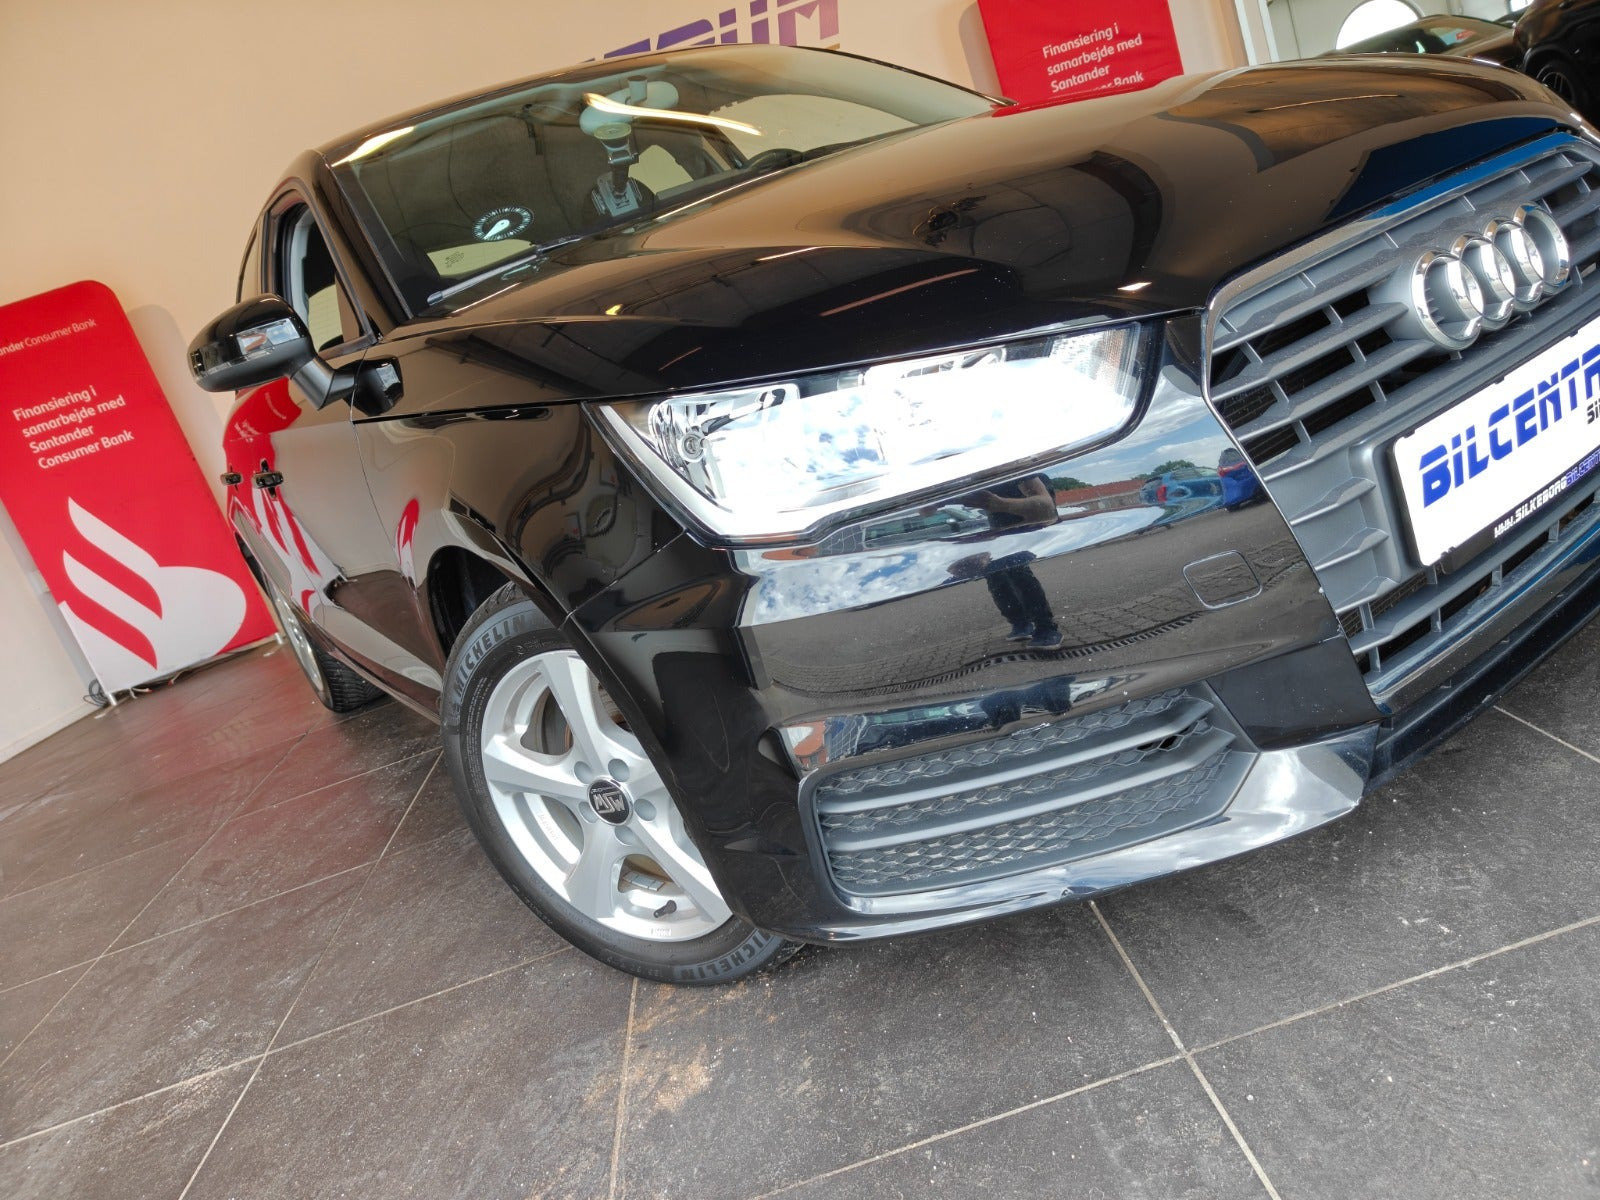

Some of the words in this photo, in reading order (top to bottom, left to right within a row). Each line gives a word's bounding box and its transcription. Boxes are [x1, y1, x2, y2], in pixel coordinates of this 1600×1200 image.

[1042, 29, 1114, 58] Finansiering
[1113, 22, 1120, 35] i
[1046, 44, 1115, 76] samarbejde
[1116, 33, 1143, 53] med
[1050, 65, 1110, 93] Santander
[24, 327, 72, 347] Consumer
[72, 318, 97, 333] Bank
[13, 388, 91, 421] Finansiering
[91, 385, 97, 397] i
[22, 405, 96, 438] samarbejde
[97, 395, 126, 414] med
[29, 424, 95, 454] Santander
[38, 440, 100, 470] Consumer
[102, 429, 135, 449] Bank
[454, 604, 526, 698] MICHELIN
[592, 789, 626, 814] MSW
